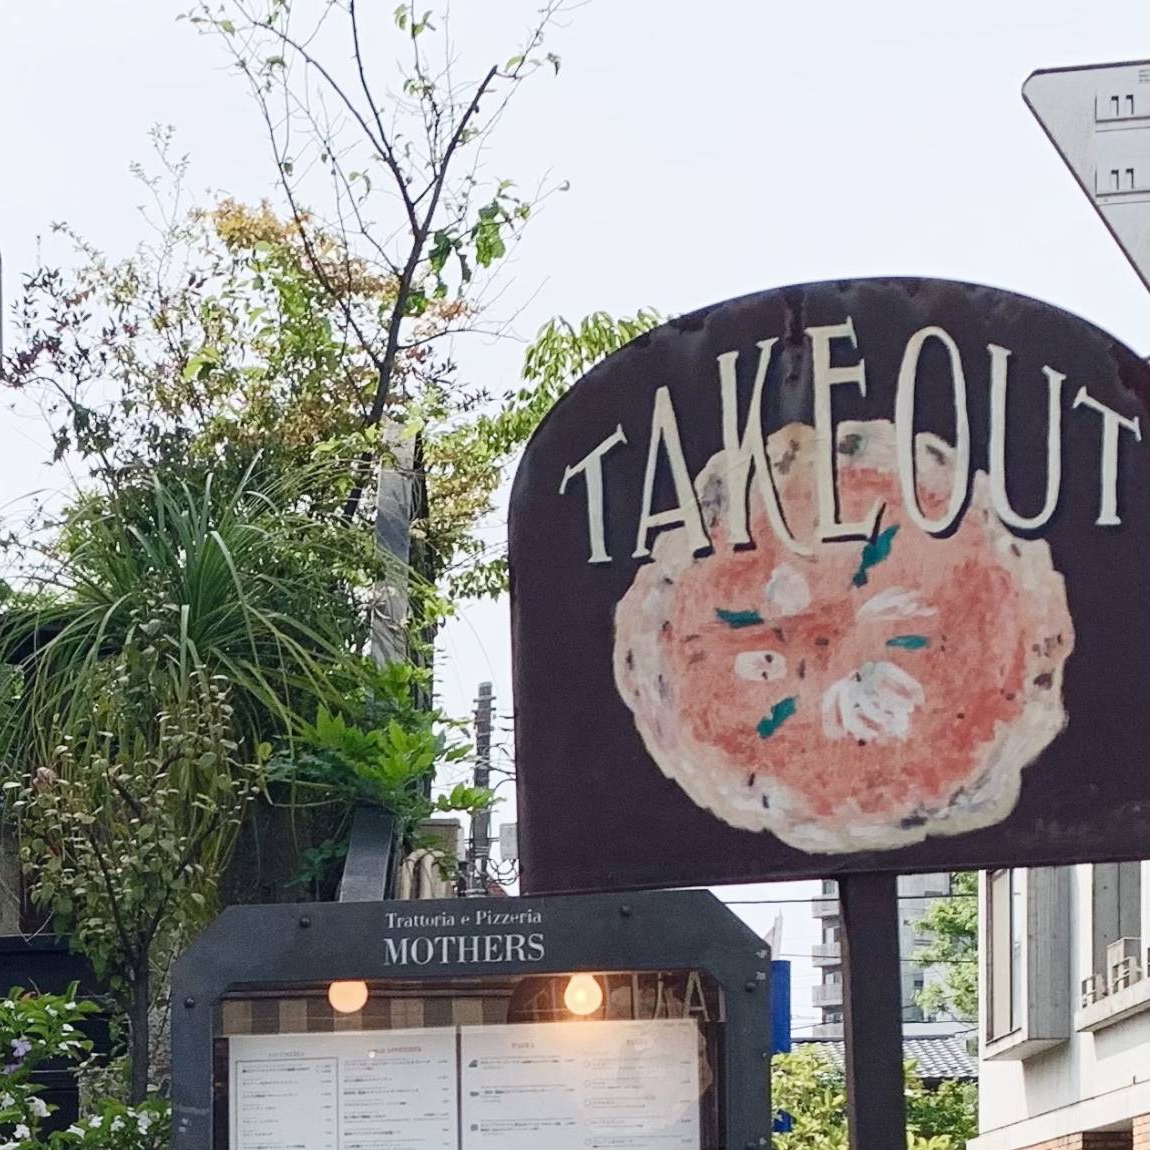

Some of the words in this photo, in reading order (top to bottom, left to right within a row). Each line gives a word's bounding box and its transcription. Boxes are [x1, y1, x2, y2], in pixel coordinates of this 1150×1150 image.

[559, 317, 1143, 565] TAKEOUT
[385, 911, 456, 929] Trattoria
[460, 915, 471, 925] e
[475, 908, 543, 926] Pizzeria
[383, 932, 546, 967] MOTHERS
